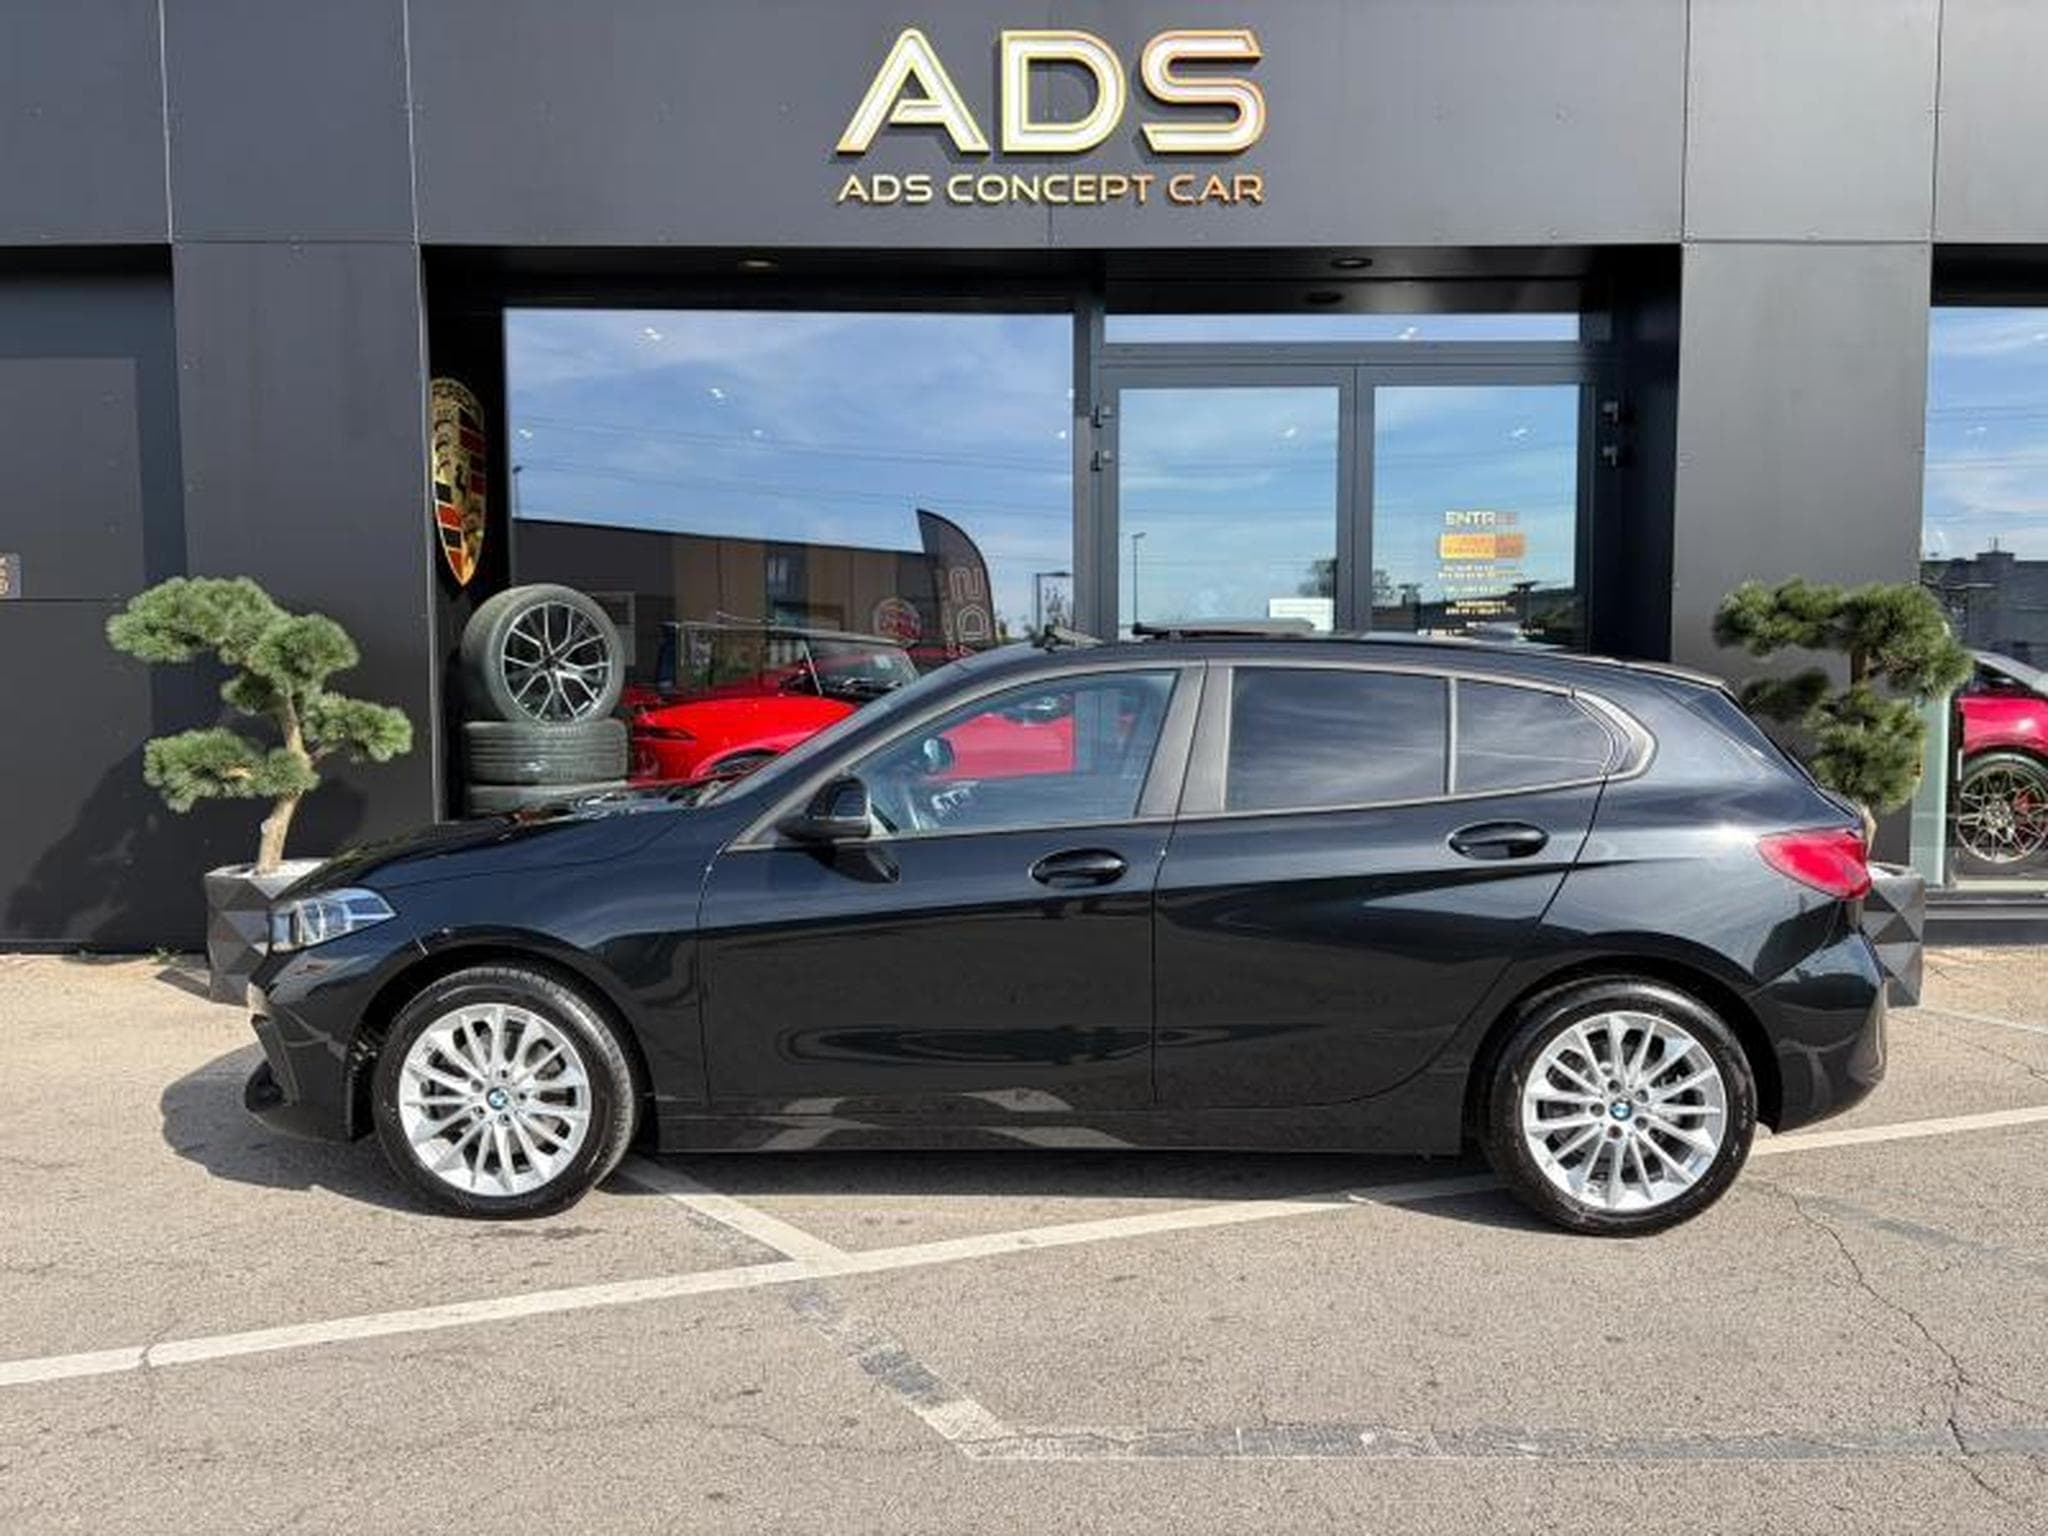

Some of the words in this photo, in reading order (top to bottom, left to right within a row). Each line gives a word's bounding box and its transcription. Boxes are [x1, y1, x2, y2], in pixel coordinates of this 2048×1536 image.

[836, 27, 1267, 155] ADS
[837, 174, 934, 204] ADS
[946, 174, 1156, 204] CONCEPT
[1166, 174, 1266, 204] CAR
